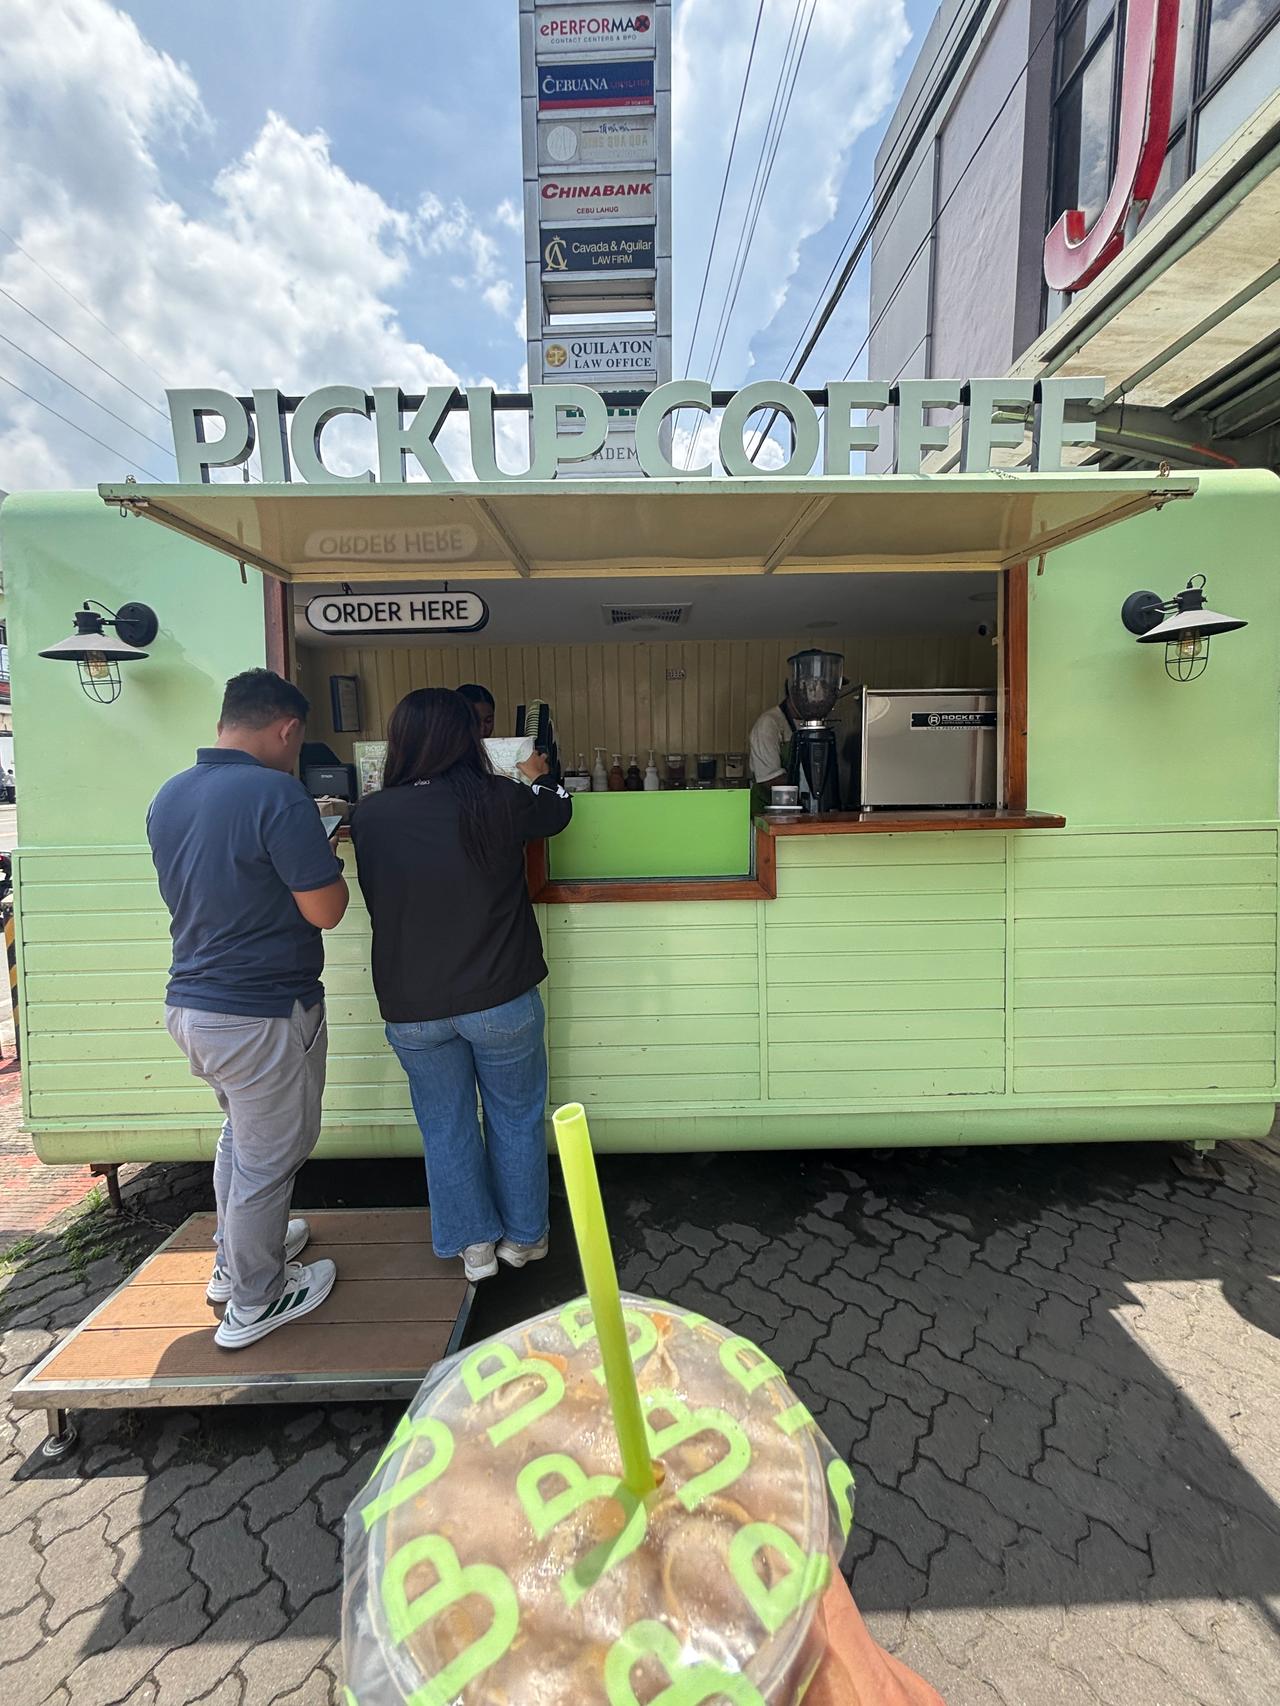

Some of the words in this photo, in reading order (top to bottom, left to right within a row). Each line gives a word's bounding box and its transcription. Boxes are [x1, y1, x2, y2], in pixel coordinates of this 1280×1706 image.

[541, 182, 653, 199] CHINABANK
[596, 206, 619, 214] LAHUG
[572, 242, 609, 253] Cavada
[611, 241, 618, 251] &
[620, 239, 652, 254] Aguilar
[592, 256, 611, 265] LAW
[612, 254, 632, 264] FIRM
[571, 340, 653, 358] QUILATON
[574, 359, 603, 369] LAW
[606, 357, 651, 368] OFFICE
[165, 384, 608, 484] PICKUP
[635, 376, 1106, 478] COFFEE
[322, 602, 402, 624] ORDER
[410, 600, 469, 621] HERE
